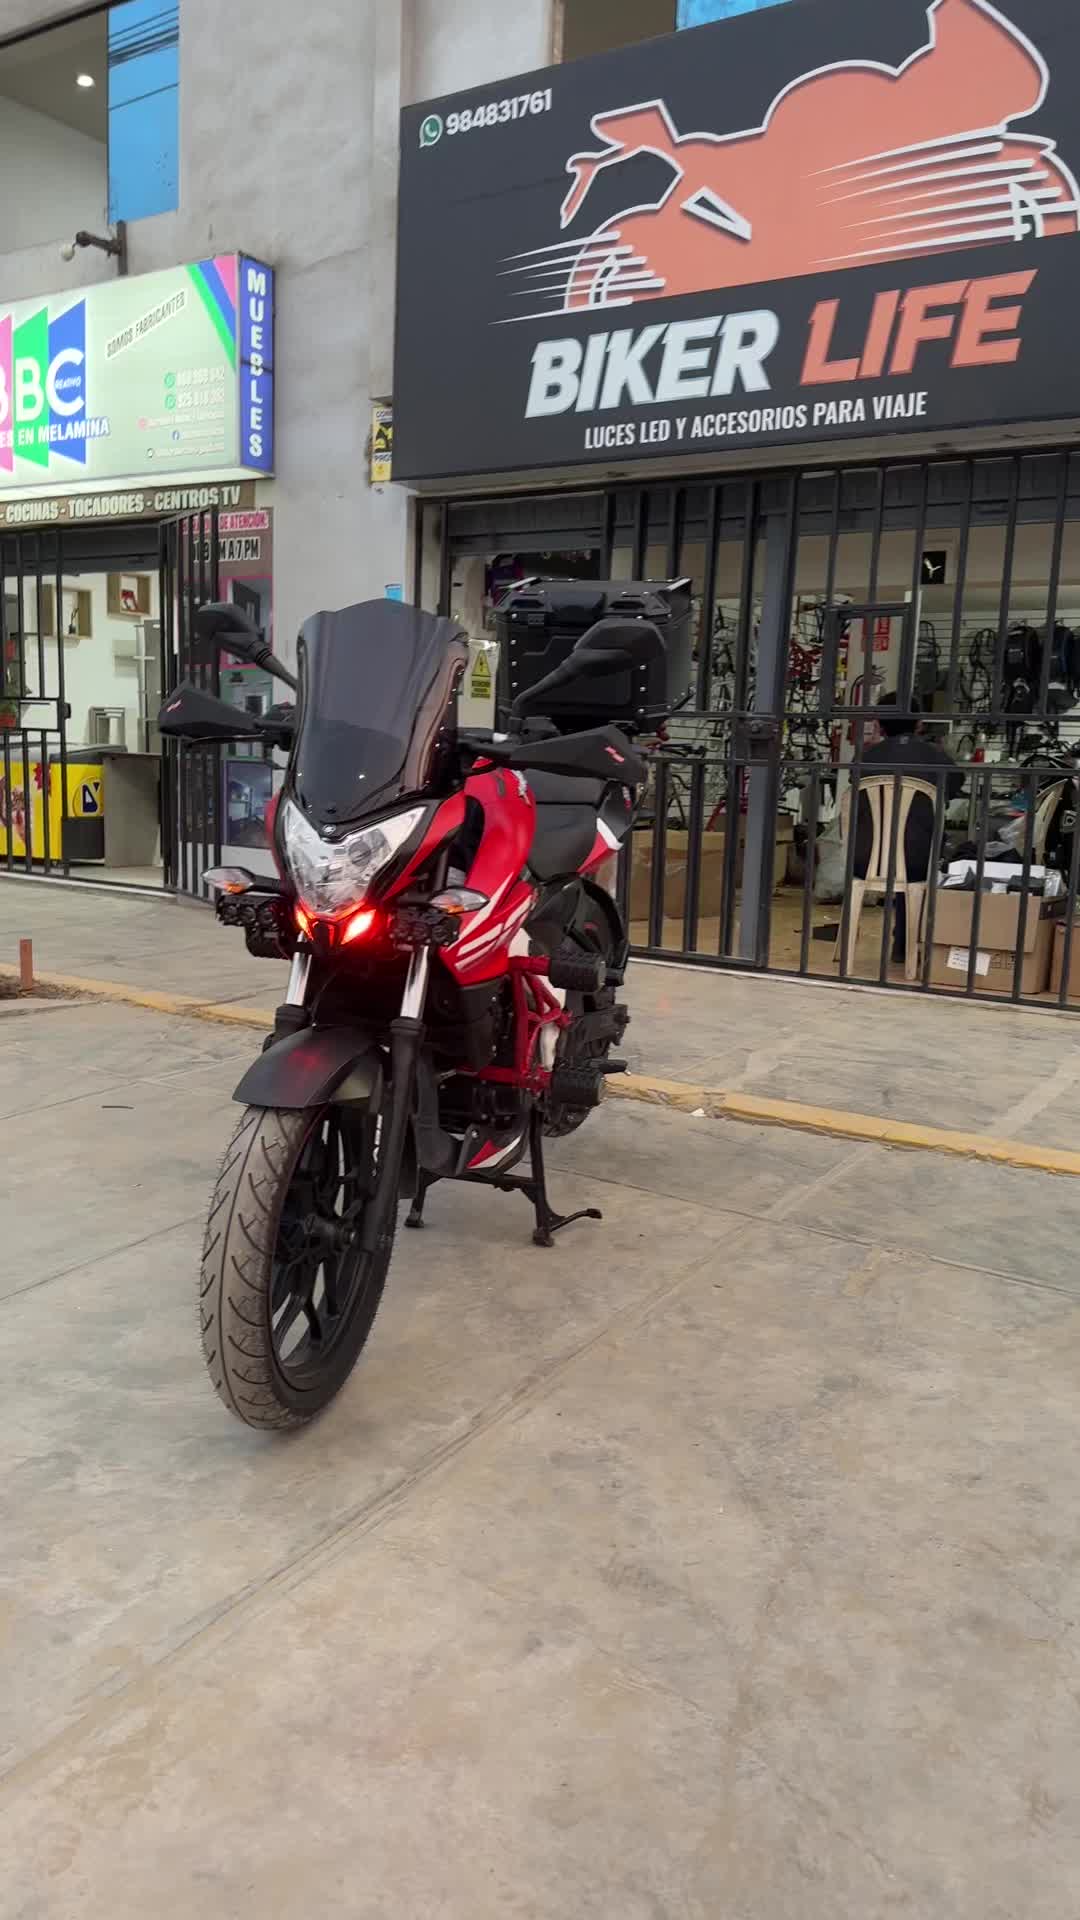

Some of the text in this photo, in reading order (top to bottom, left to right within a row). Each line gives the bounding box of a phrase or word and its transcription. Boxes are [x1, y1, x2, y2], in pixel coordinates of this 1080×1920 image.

[446, 88, 552, 135] 984831761
[247, 268, 266, 457] MUEBLES
[524, 268, 1038, 418] BIKER LIFE
[18, 427, 34, 446] EN
[38, 417, 110, 444] MELAMINA
[584, 391, 928, 449] LUCES LED Y ACCESORIOS PARA VIAJE
[6, 504, 59, 523] COCINAS
[68, 494, 145, 518] TOCADORES
[154, 487, 219, 511] CENTROS
[221, 485, 241, 506] TV
[244, 537, 259, 559] PM
